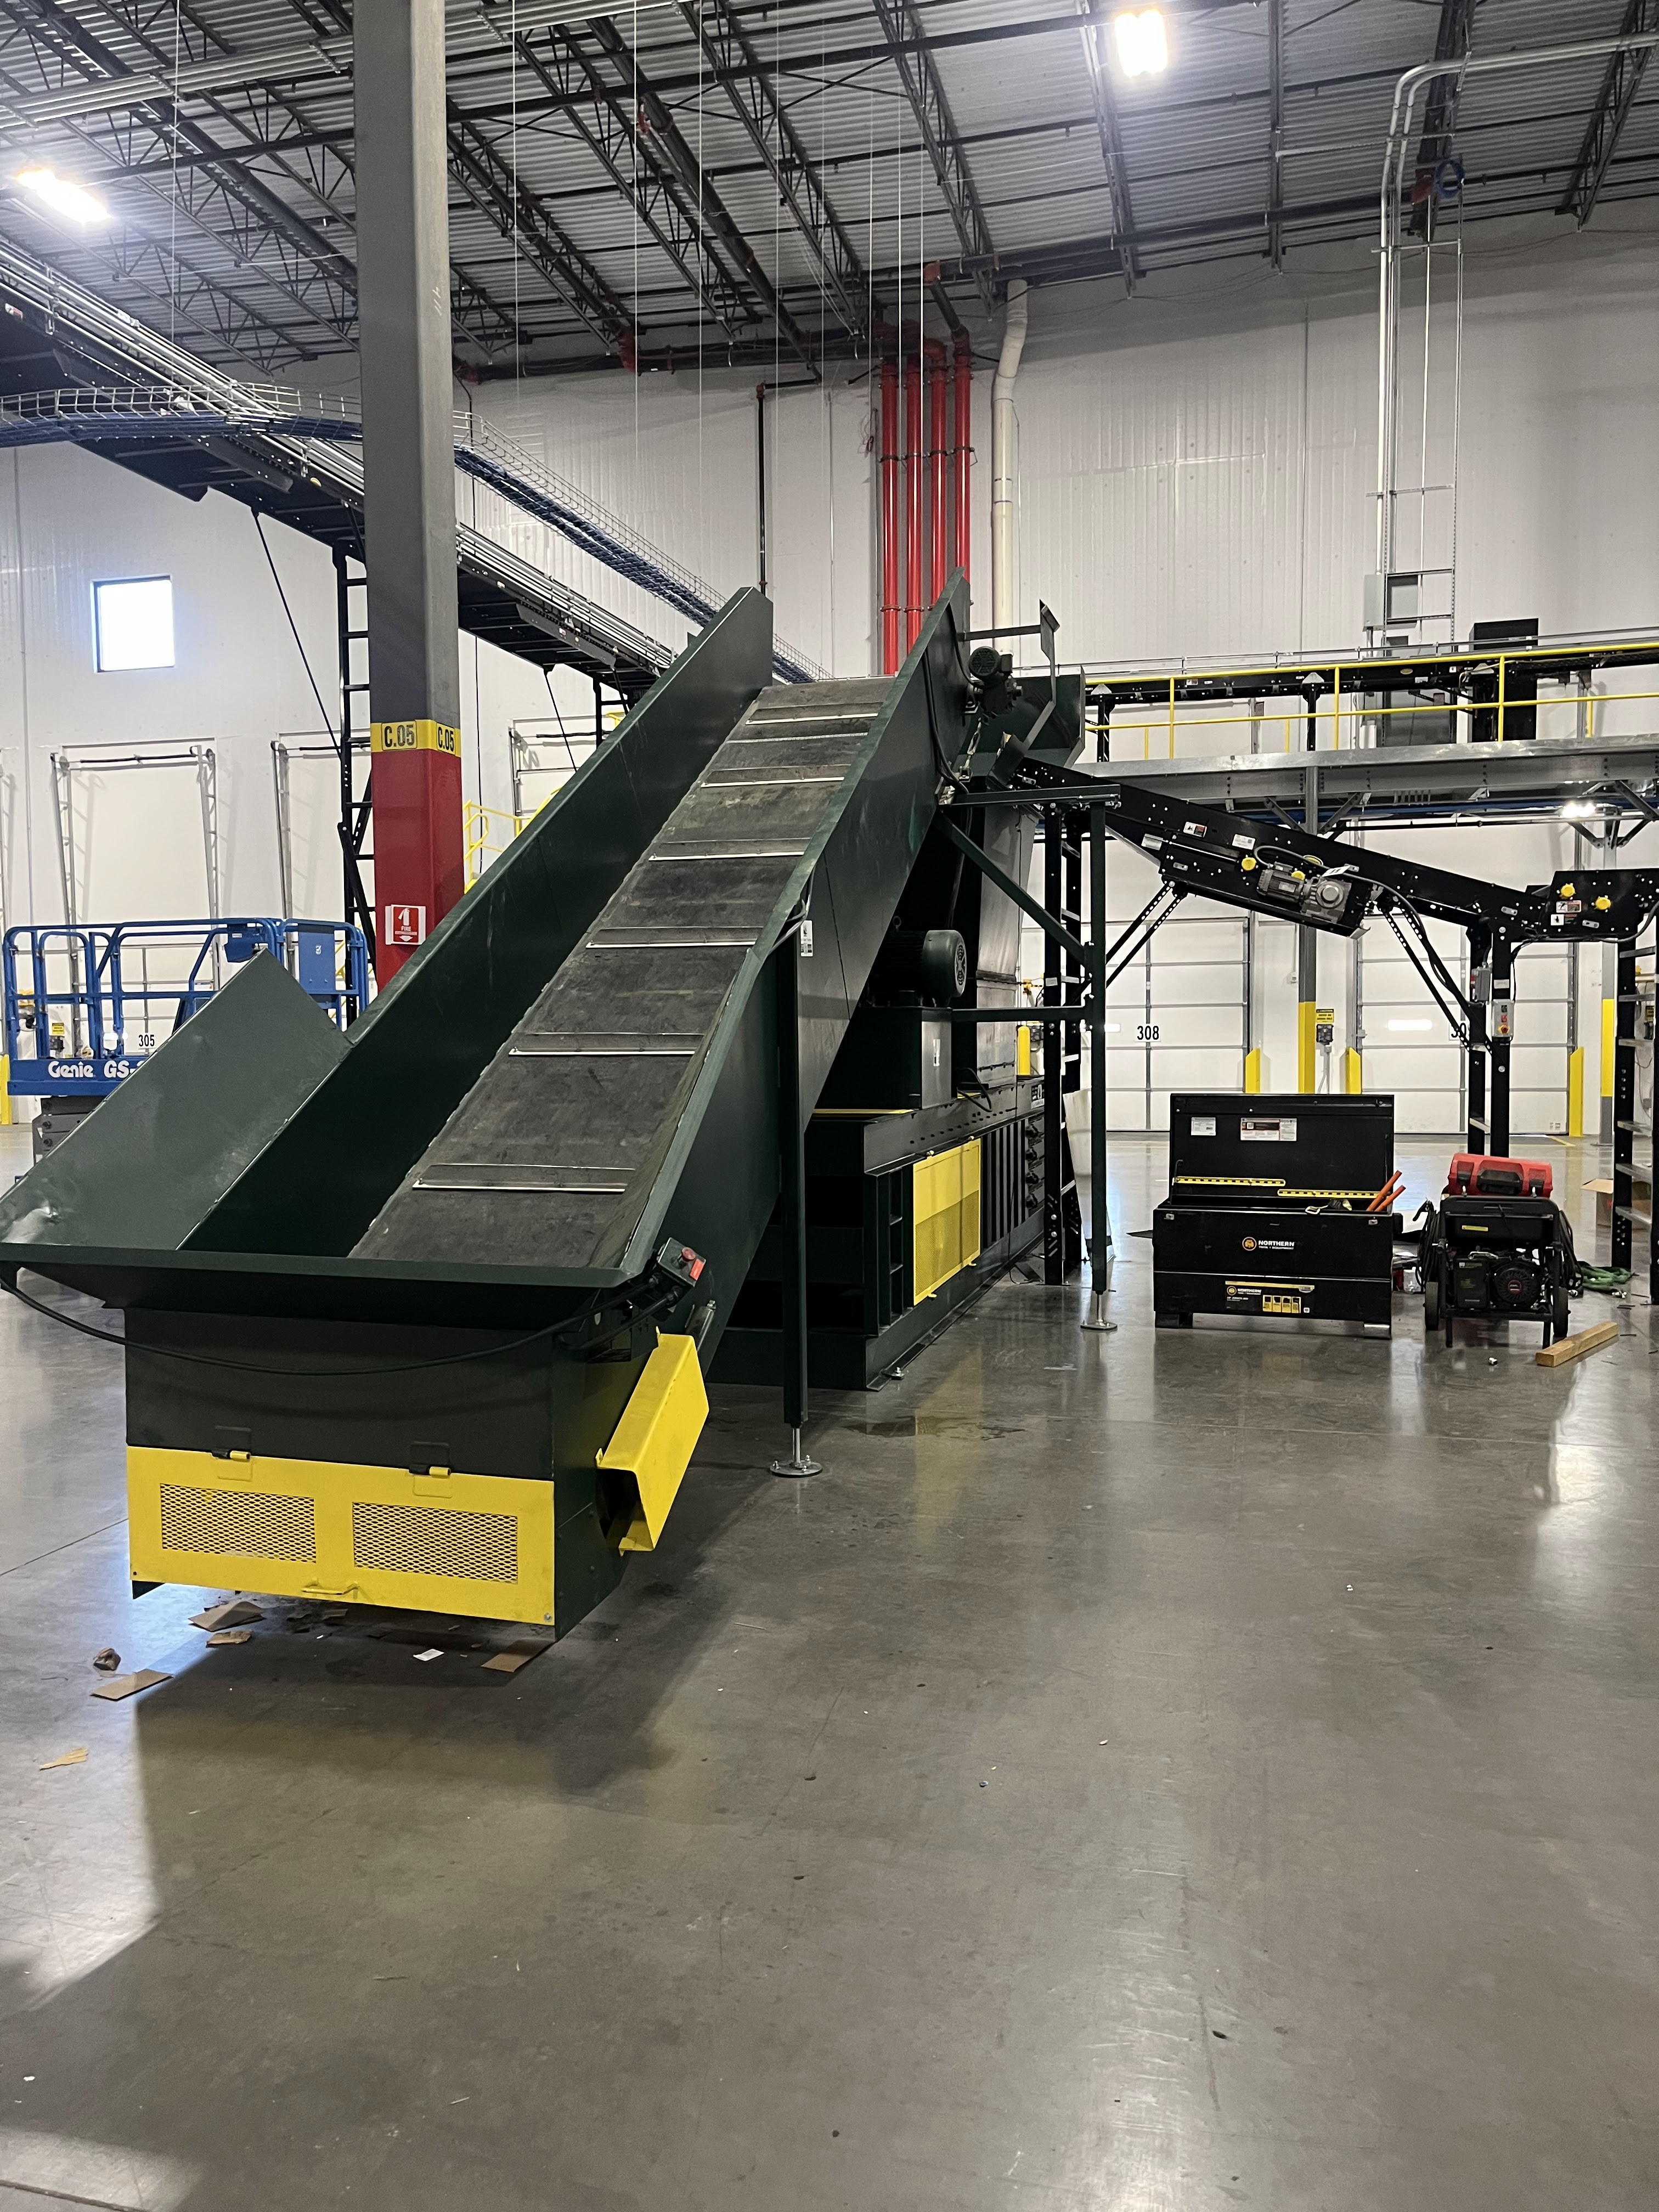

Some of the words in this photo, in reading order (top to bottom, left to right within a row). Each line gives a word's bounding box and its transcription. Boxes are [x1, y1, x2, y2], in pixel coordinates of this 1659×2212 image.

[384, 725, 415, 747] C.05
[438, 726, 454, 752] C.05
[138, 1034, 155, 1047] 305
[1137, 1025, 1159, 1040] 308
[48, 1060, 94, 1078] Genie
[104, 1060, 144, 1078] GS-
